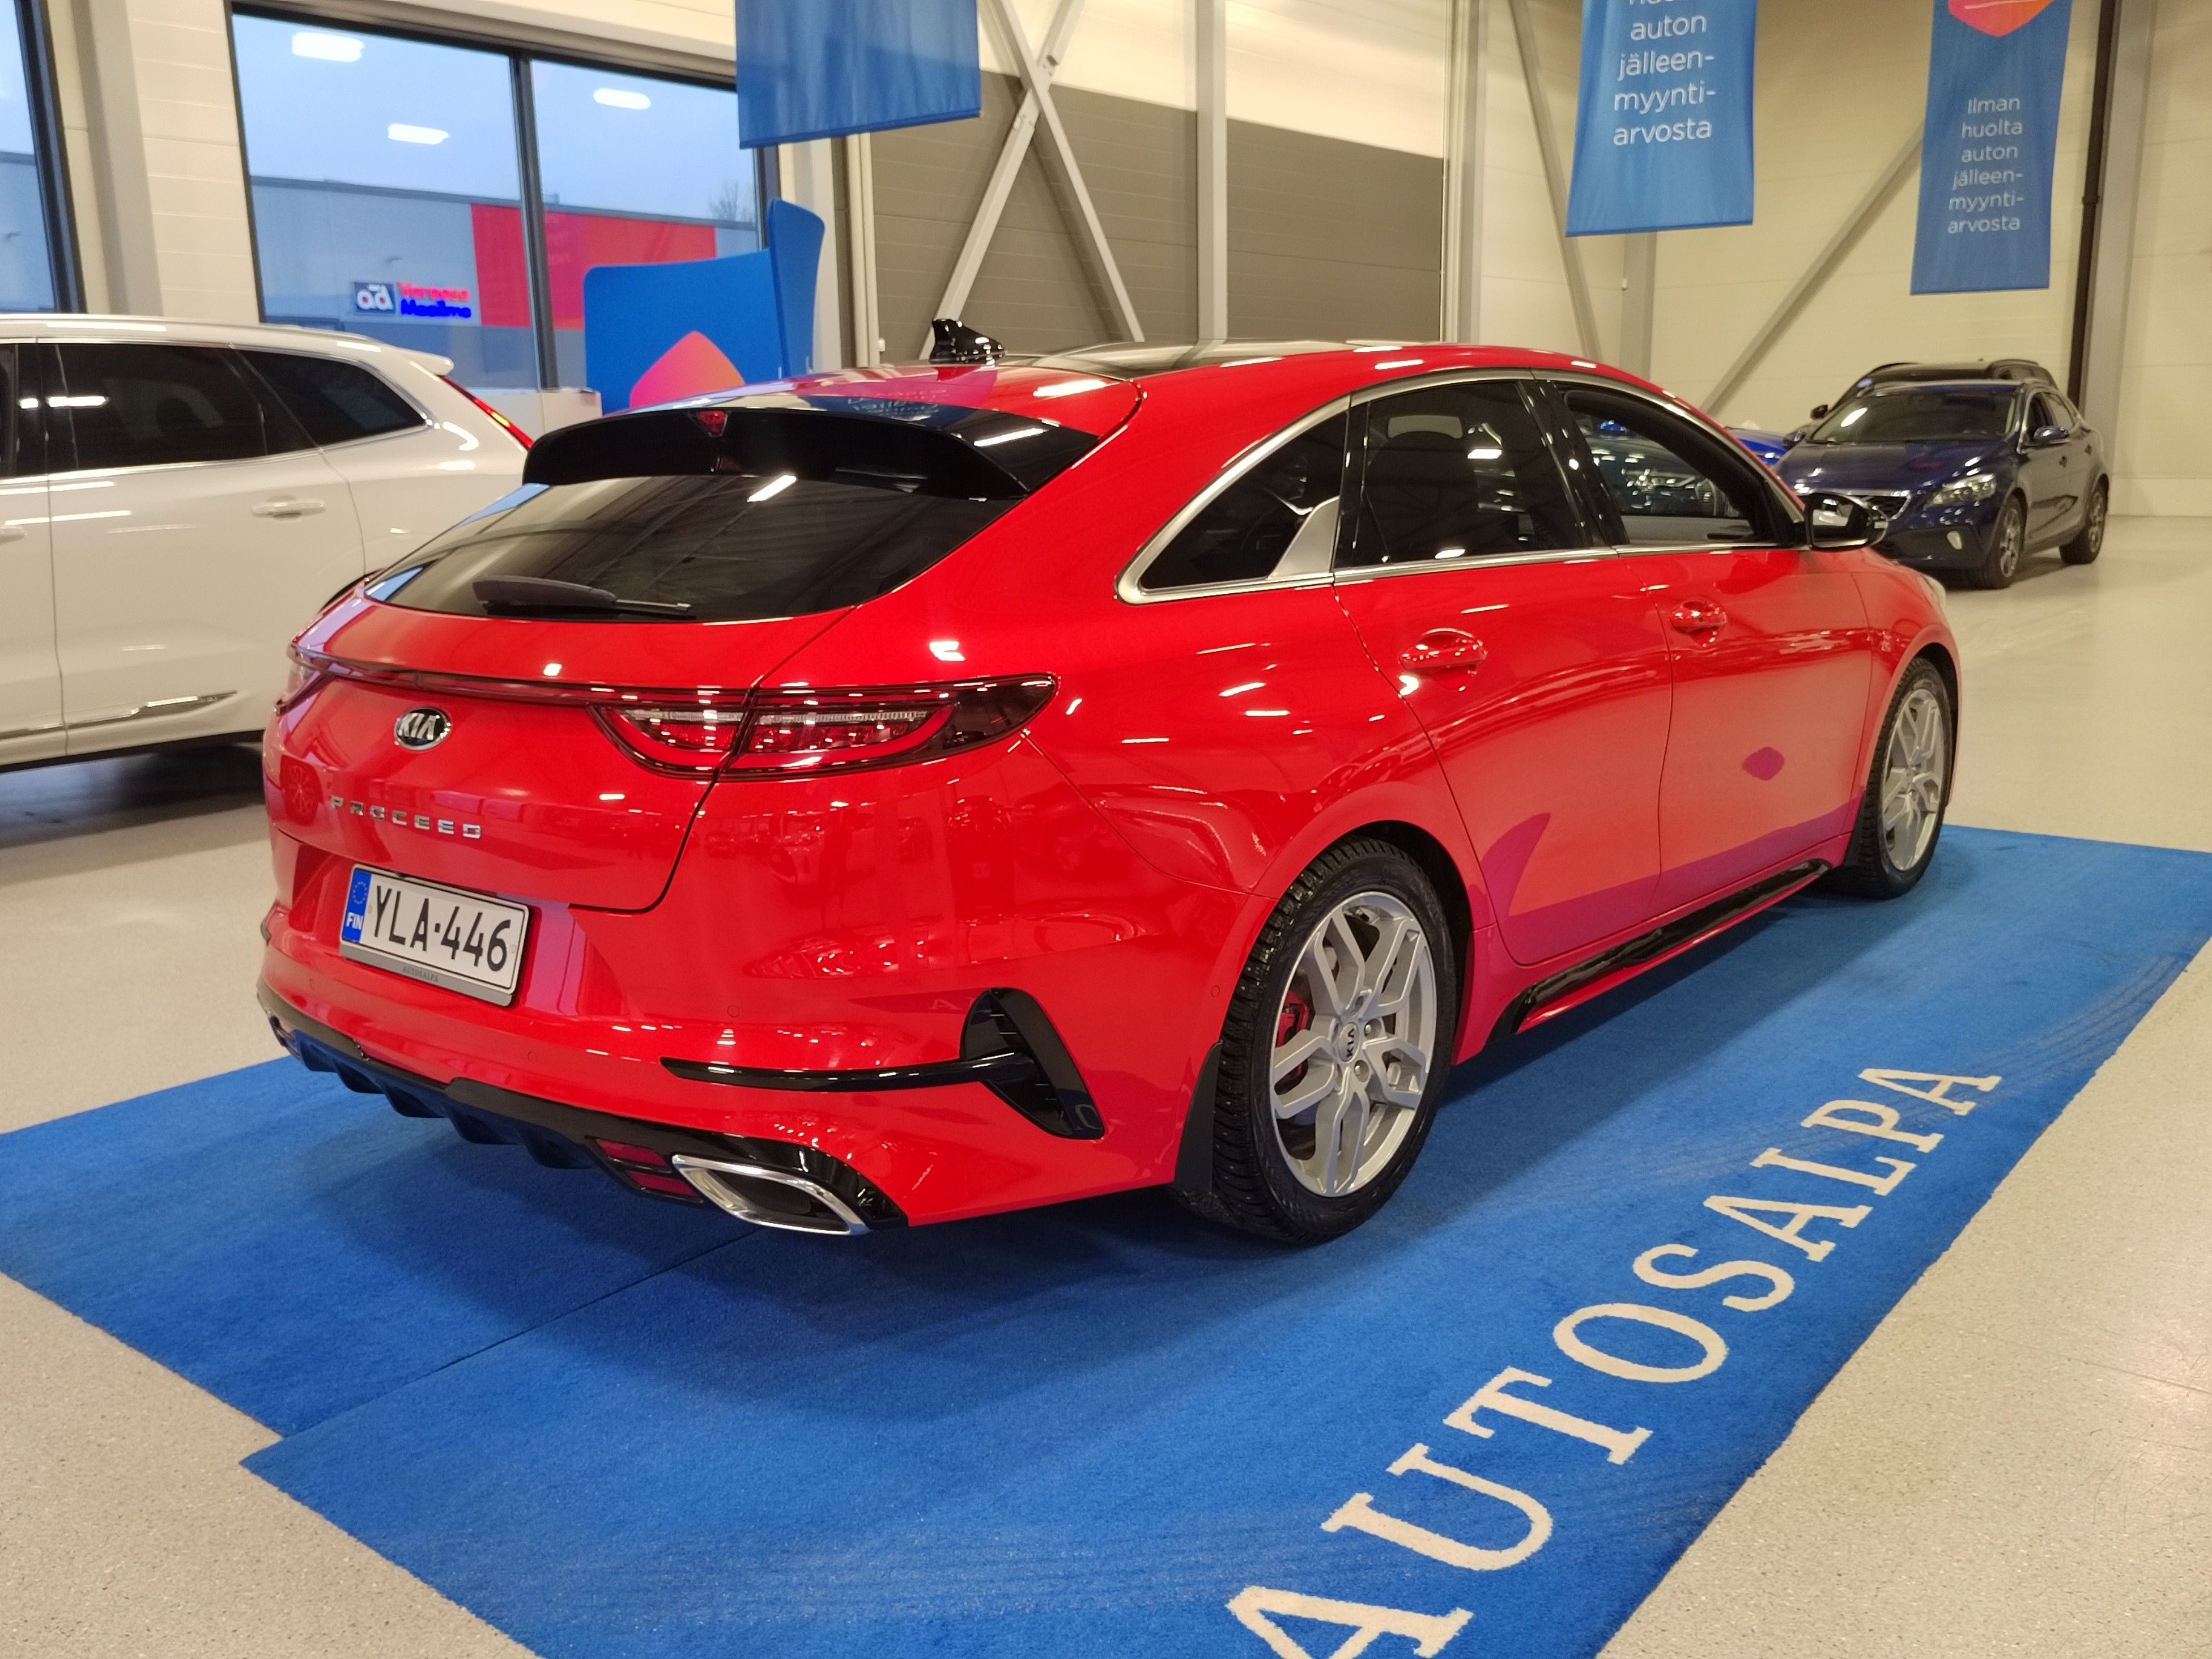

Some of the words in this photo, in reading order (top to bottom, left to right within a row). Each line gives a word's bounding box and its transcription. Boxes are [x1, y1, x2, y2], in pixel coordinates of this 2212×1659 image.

[1631, 15, 1707, 41] auton
[1617, 50, 1715, 81] jälleen-
[1614, 80, 1717, 114] myynti-
[1967, 97, 2020, 114] Ilman
[1613, 117, 1712, 146] arvosta
[1961, 119, 2023, 139] huolta
[1962, 144, 2018, 163] auton
[1952, 169, 2024, 190] jälleen-
[1949, 192, 2024, 213] myynti-
[1947, 215, 2021, 235] arvosta
[346, 911, 364, 931] FIN
[373, 885, 512, 972] YLA-446
[1346, 1027, 1355, 1058] KIA
[1226, 1067, 2002, 1659] AUTOSALPA
